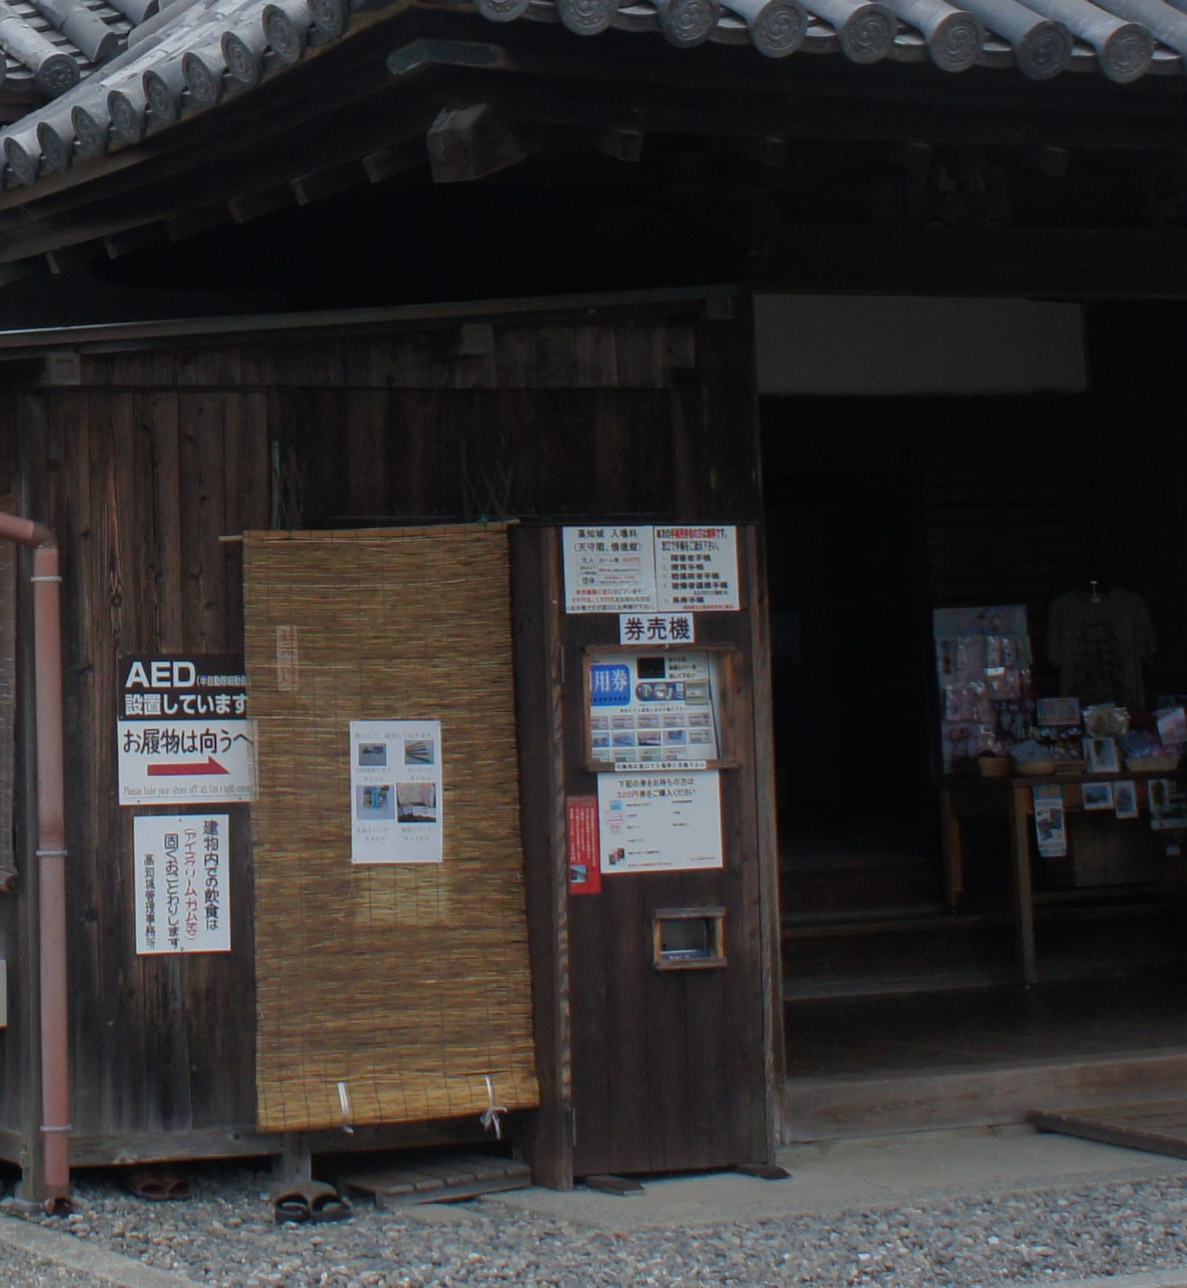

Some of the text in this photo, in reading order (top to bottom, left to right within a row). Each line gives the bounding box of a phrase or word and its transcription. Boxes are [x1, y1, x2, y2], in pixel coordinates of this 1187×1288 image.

[624, 616, 690, 641] 券売機
[125, 661, 196, 688] AED
[590, 669, 628, 692] 用券
[125, 693, 249, 716] 設置しています
[123, 727, 253, 755] お履物は向うへ
[203, 819, 219, 931] 建物内での飲食は
[164, 833, 180, 949] 固くおことわりします
